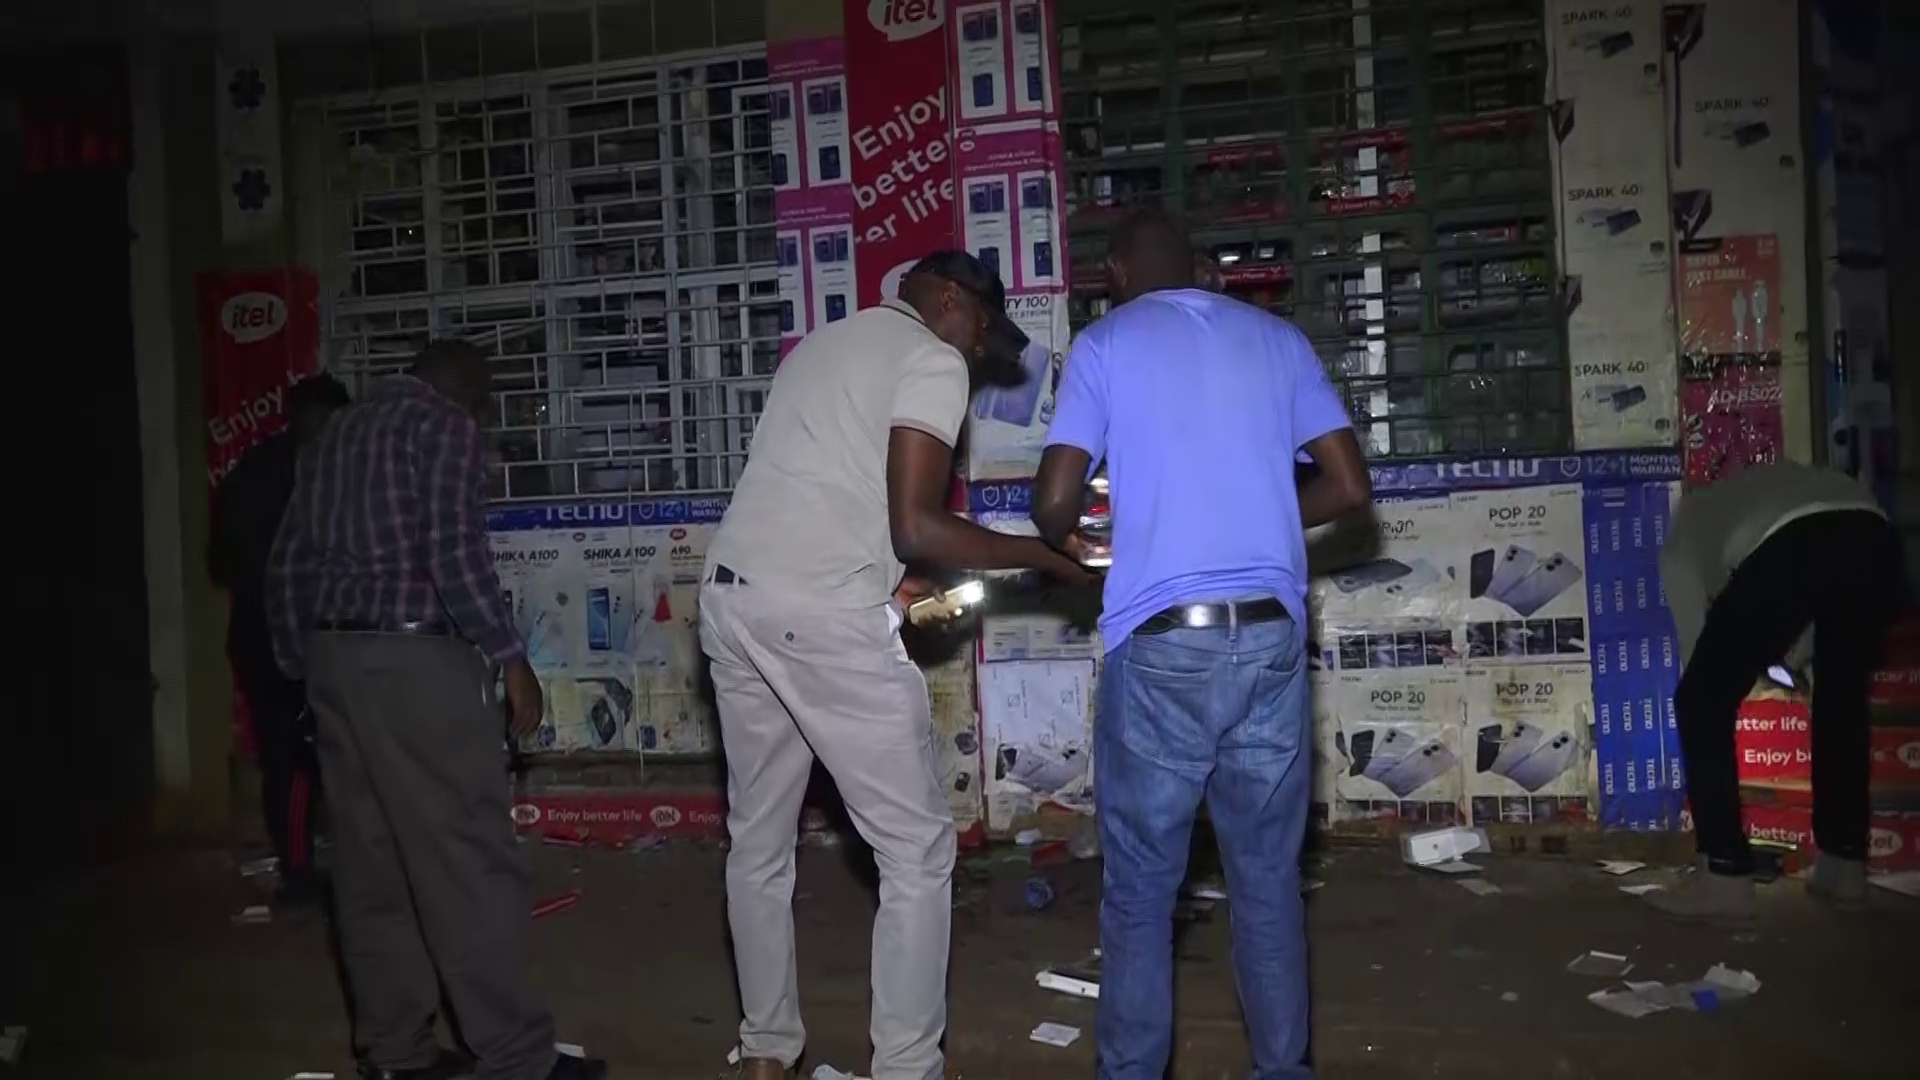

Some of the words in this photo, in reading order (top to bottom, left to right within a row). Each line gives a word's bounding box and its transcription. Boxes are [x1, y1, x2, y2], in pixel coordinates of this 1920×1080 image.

[1561, 9, 1607, 25] SPARK
[1694, 98, 1742, 113] SPARK
[851, 83, 946, 160] Enjoy
[851, 132, 959, 211] better
[901, 177, 954, 223] life
[1567, 186, 1614, 201] SPARK
[232, 299, 275, 329] itel
[1026, 295, 1049, 308] 100
[1574, 361, 1621, 377] SPARK
[207, 384, 284, 445] Enjoy
[1489, 506, 1522, 521] POP
[1528, 505, 1547, 519] 20
[1590, 522, 1599, 555] TECNO
[1610, 519, 1620, 551] TECNO
[1633, 516, 1643, 547] TECNO
[1654, 514, 1663, 545] TECNO
[529, 548, 559, 561] A100
[583, 549, 621, 561] SHIKA
[625, 546, 656, 559] A100
[670, 546, 691, 555] A90
[1593, 582, 1603, 616] TECNO
[1614, 579, 1624, 612] TECNO
[1637, 577, 1646, 609] TECNO
[1597, 643, 1606, 674] TECNO
[1619, 640, 1628, 671] TECNO
[1640, 637, 1650, 669] TECNO
[1662, 635, 1672, 667] TECNO
[1370, 689, 1402, 703] POP
[1407, 689, 1426, 704] 20
[1495, 683, 1528, 696] POP
[1535, 682, 1553, 696] 20
[1600, 703, 1610, 735] TECNO
[1622, 700, 1632, 731] TECNO
[1643, 697, 1653, 730] TECNO
[1780, 715, 1808, 732] life
[1744, 748, 1792, 767] Enjoy
[1604, 762, 1614, 795] TECNO
[1626, 760, 1636, 793] TECNO
[1646, 757, 1656, 790] TECNO
[1670, 757, 1681, 790] TECNO
[547, 809, 580, 823] Enjoy
[583, 809, 620, 821] better
[623, 809, 642, 821] life
[689, 810, 723, 826] Enjoy
[1750, 822, 1807, 843] better
